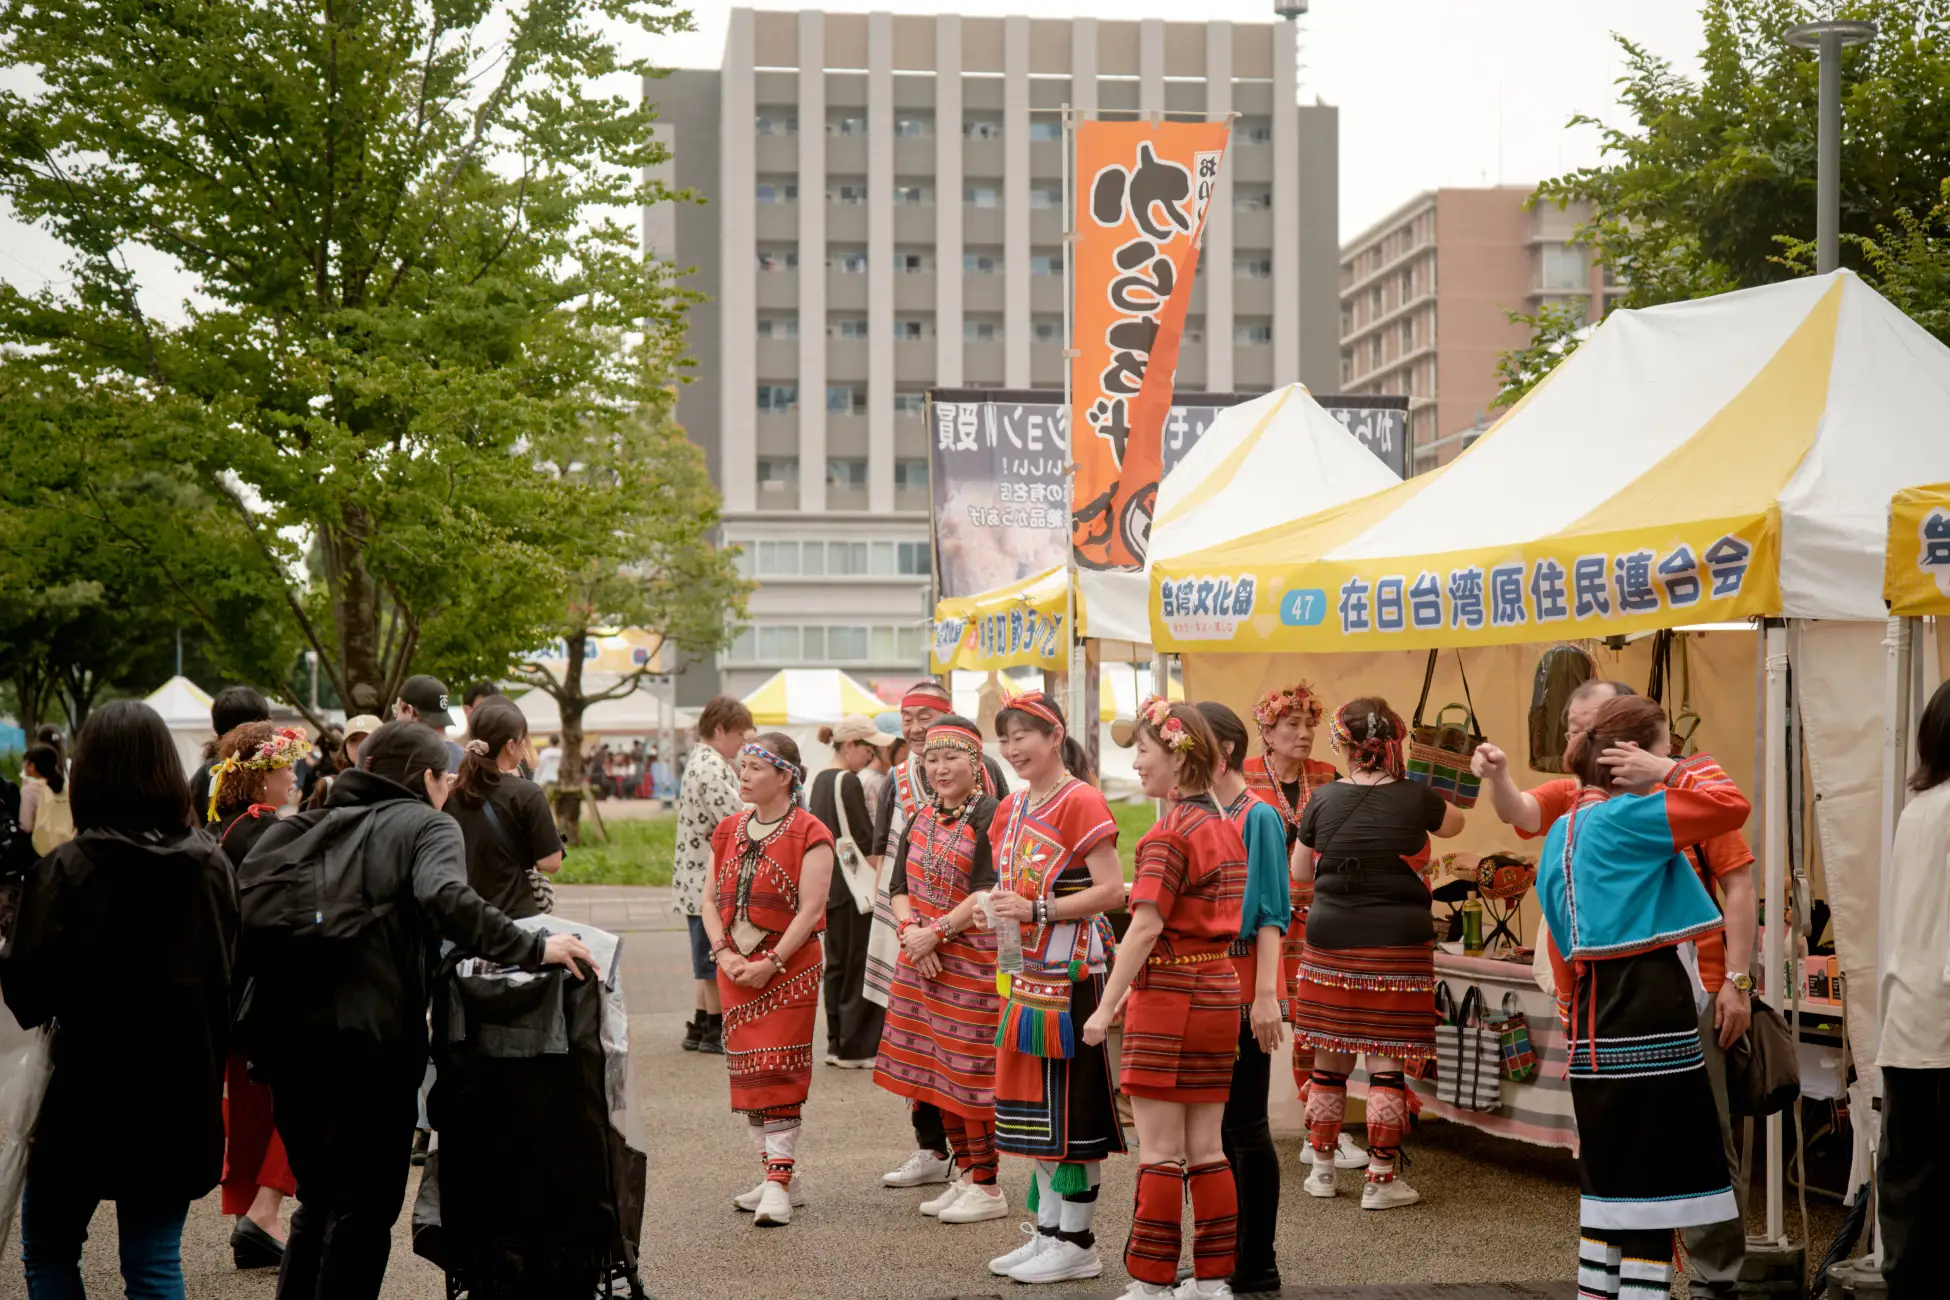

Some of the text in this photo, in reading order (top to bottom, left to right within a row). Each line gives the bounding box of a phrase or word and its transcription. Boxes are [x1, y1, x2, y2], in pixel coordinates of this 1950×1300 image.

[1291, 595, 1314, 621] 47
[1338, 534, 1752, 631] 在日台湾原住民連合会
